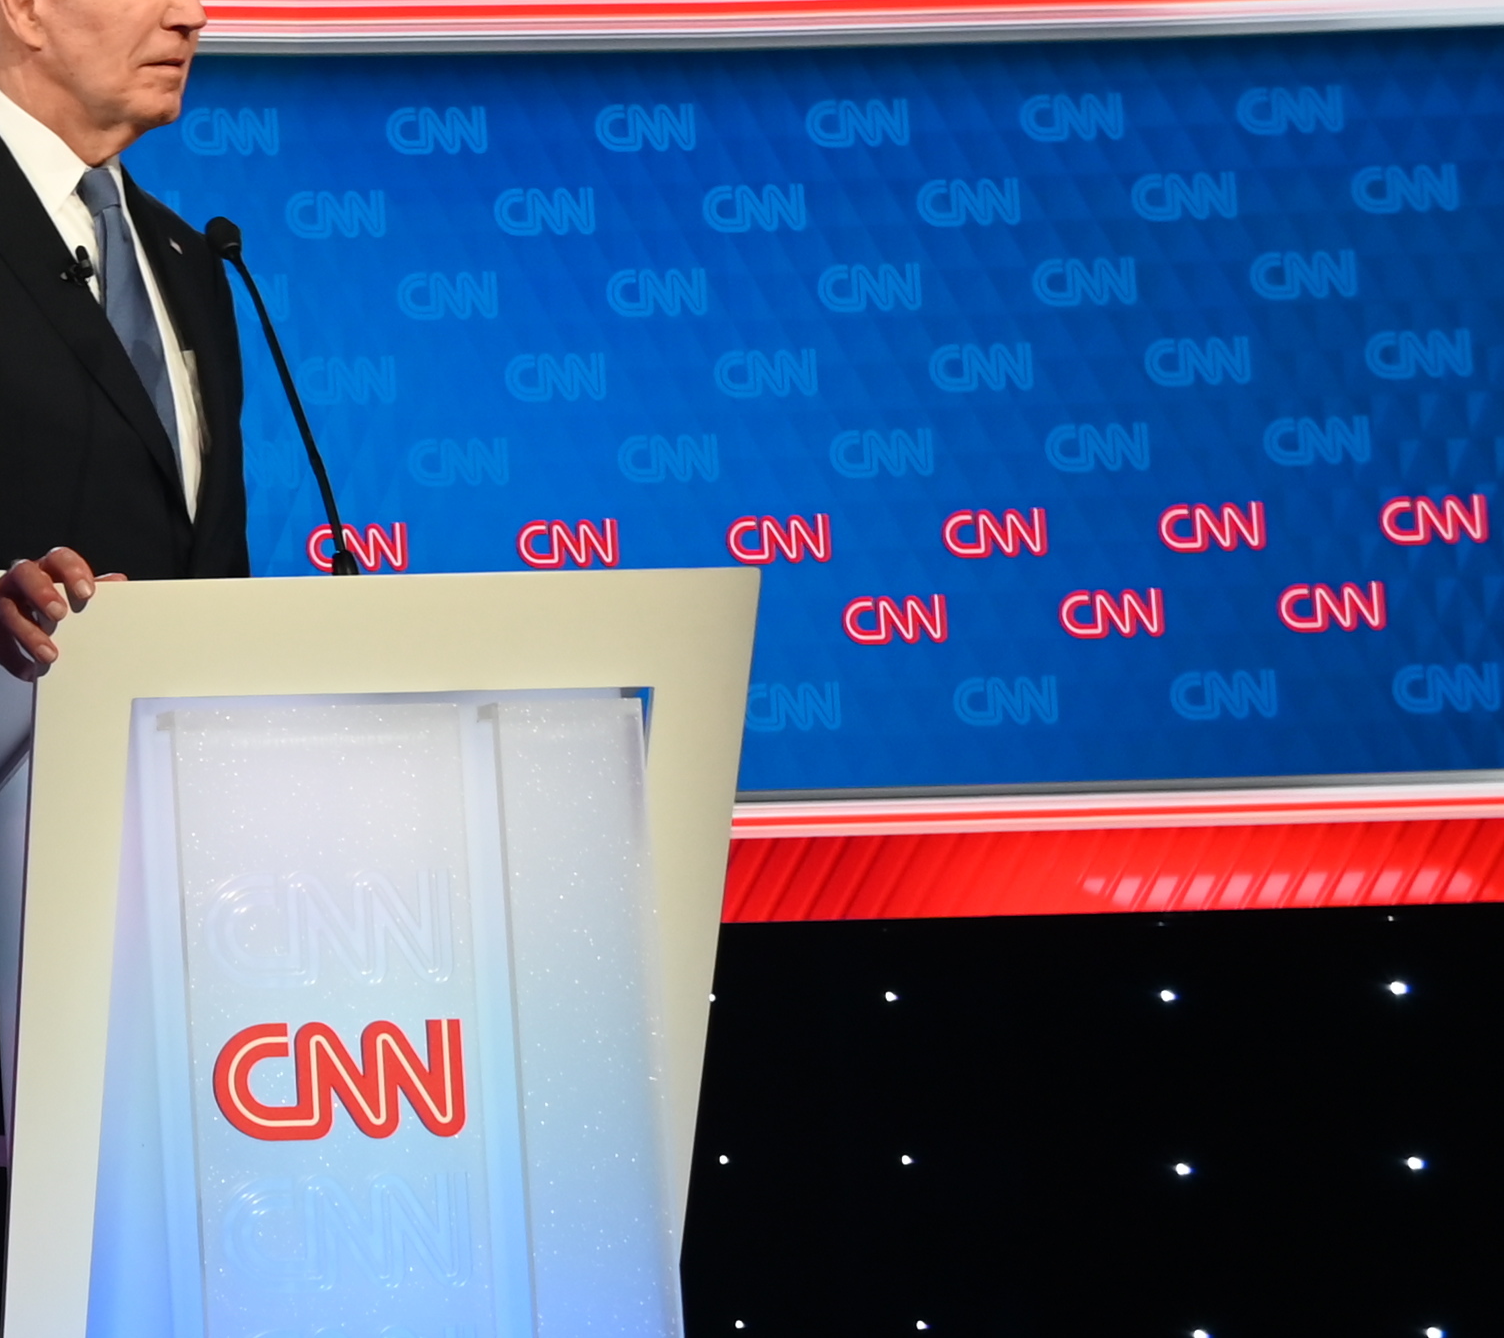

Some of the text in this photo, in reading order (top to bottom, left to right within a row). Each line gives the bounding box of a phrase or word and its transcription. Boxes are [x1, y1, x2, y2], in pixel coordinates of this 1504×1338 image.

[182, 106, 279, 156] CNN
[386, 106, 488, 155] CNN
[595, 104, 697, 153] CNN
[806, 98, 910, 148] CNN
[1019, 92, 1125, 143] CNN
[1235, 86, 1345, 136] CNN
[494, 186, 595, 236] CNN
[703, 183, 806, 233] CNN
[917, 178, 1021, 227] CNN
[1131, 171, 1237, 222] CNN
[1351, 163, 1461, 214] CNN
[286, 189, 386, 240] CNN
[397, 272, 498, 321] CNN
[606, 268, 708, 317] CNN
[817, 263, 921, 313] CNN
[1032, 257, 1138, 307] CNN
[1250, 250, 1358, 300] CNN
[297, 355, 396, 405] CNN
[505, 352, 606, 403] CNN
[714, 348, 817, 399] CNN
[928, 343, 1034, 393] CNN
[1145, 336, 1251, 387] CNN
[1365, 329, 1472, 380] CNN
[408, 437, 509, 487] CNN
[617, 434, 720, 484] CNN
[830, 427, 935, 478] CNN
[1045, 422, 1150, 472] CNN
[1264, 415, 1371, 466] CNN
[517, 518, 619, 569] CNN
[726, 513, 831, 565] CNN
[942, 507, 1048, 559] CNN
[1158, 500, 1267, 552] CNN
[1380, 493, 1488, 545] CNN
[306, 521, 408, 572] CNN
[842, 593, 948, 644] CNN
[1058, 587, 1165, 639] CNN
[1278, 580, 1387, 632] CNN
[743, 680, 842, 732] CNN
[953, 675, 1059, 727] CNN
[1170, 669, 1278, 720] CNN
[1392, 662, 1500, 714] CNN
[205, 867, 455, 989] CNN
[212, 1019, 466, 1141] CNN
[222, 1170, 472, 1292] CNN
